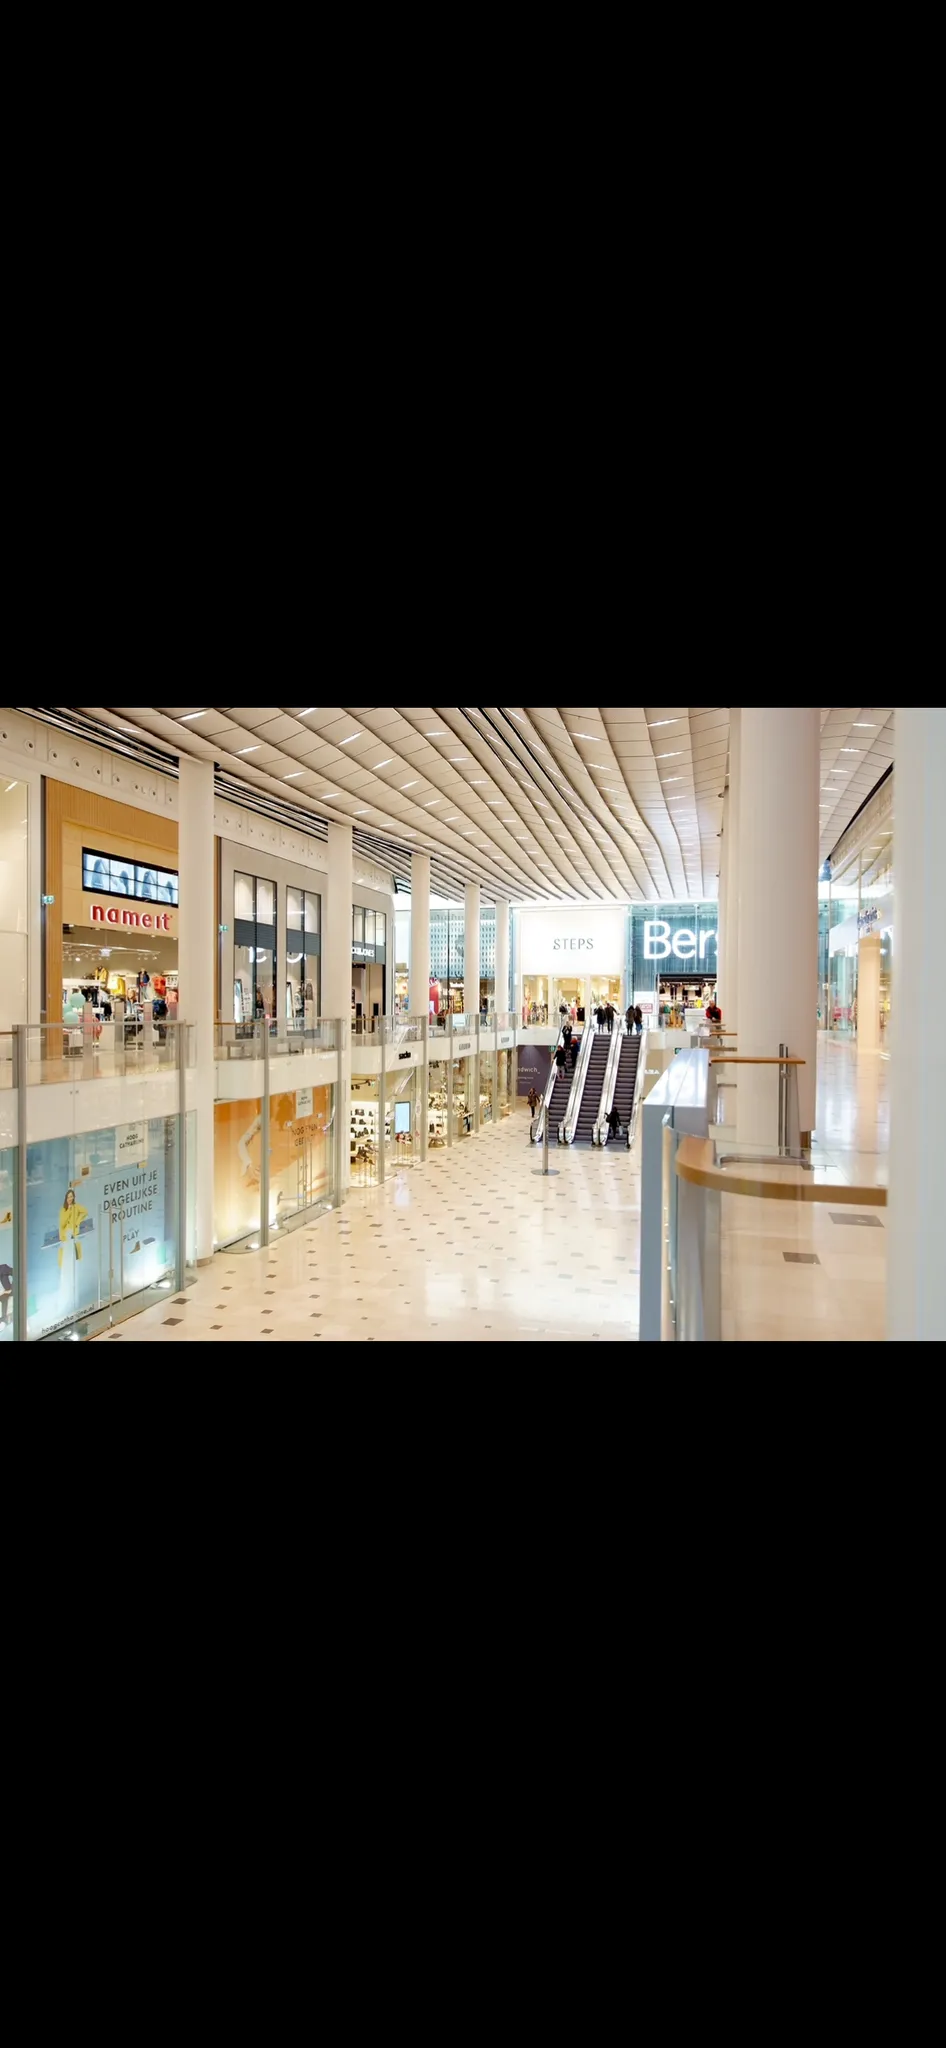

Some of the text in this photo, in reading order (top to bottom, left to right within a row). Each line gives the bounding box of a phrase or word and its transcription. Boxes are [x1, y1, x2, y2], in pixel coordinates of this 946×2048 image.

[553, 938, 594, 951] STEPS
[643, 920, 718, 960] Ber
[104, 1169, 158, 1196] EVEN UIT JE
[103, 1184, 158, 1211] DAGELIJKSE
[111, 1200, 153, 1224] ROUTINE
[122, 1229, 140, 1243] PLAY
